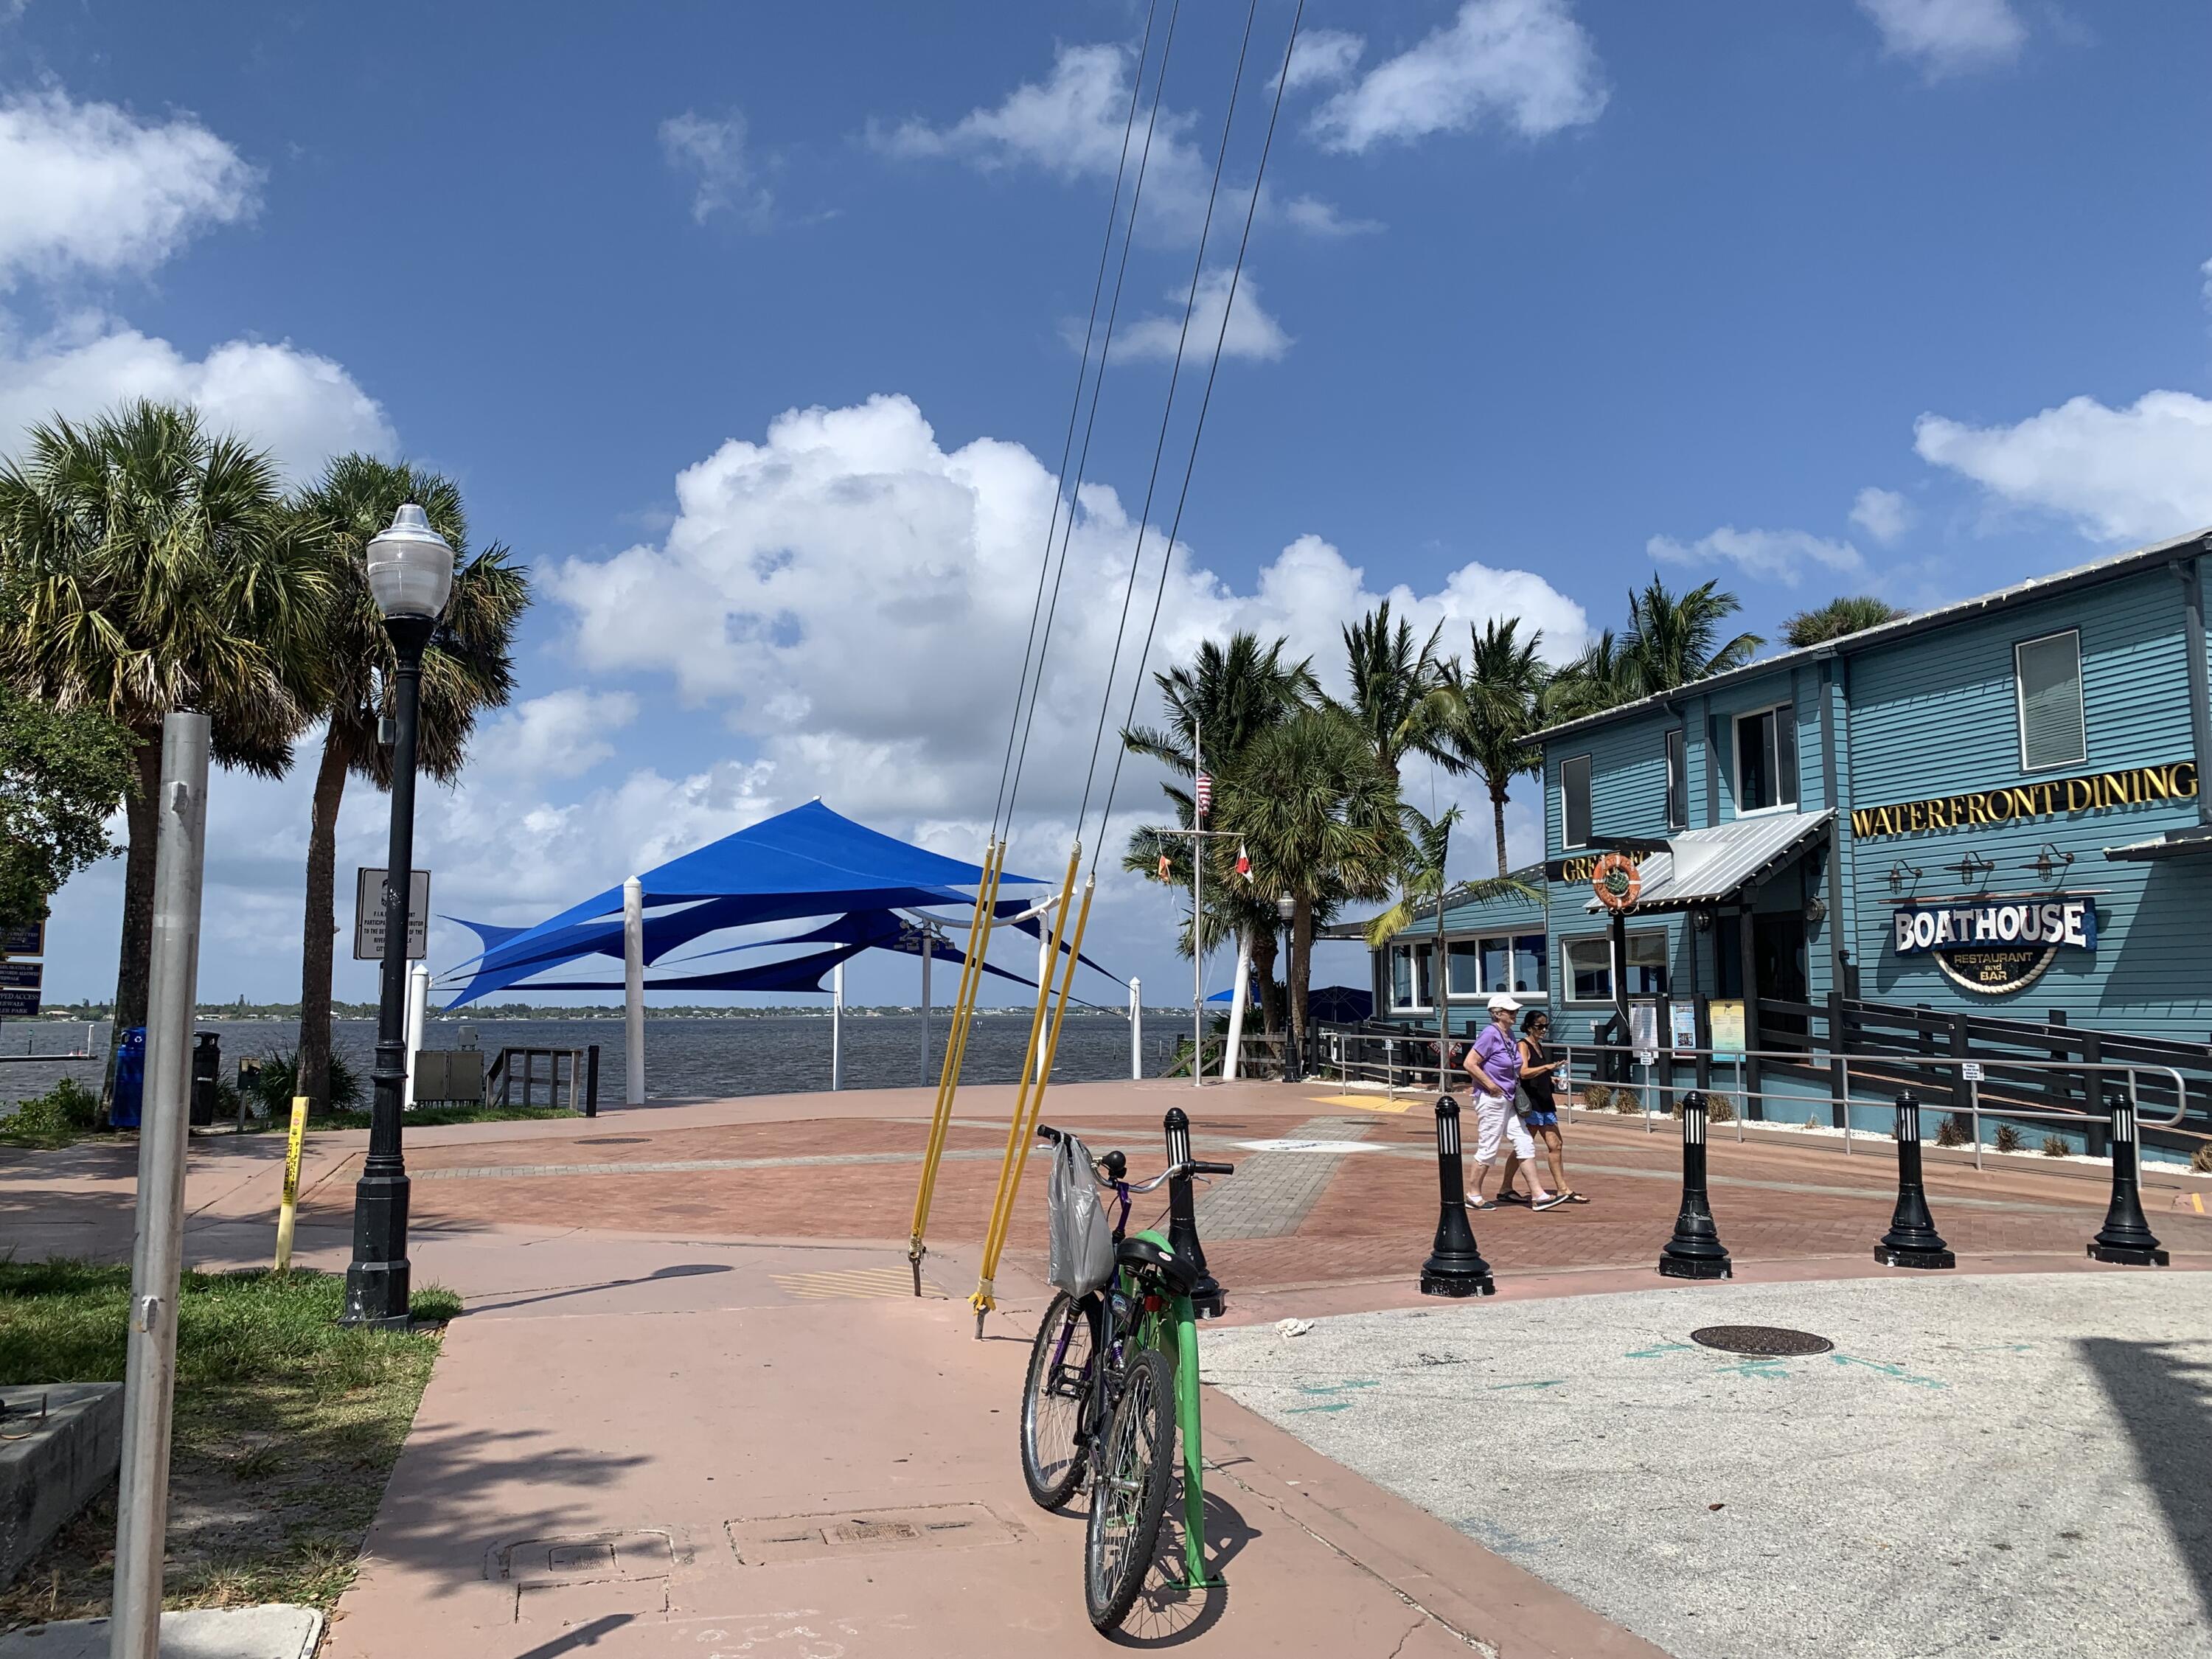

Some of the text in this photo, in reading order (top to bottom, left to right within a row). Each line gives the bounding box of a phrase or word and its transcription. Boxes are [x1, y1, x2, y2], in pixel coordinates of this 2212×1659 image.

[1852, 763, 2197, 838] WATERFRONT DINING
[1895, 900, 2086, 951] BOATHOUSE
[1954, 952, 2034, 964] RESTAURANT
[1985, 963, 2002, 971] and
[1980, 970, 2007, 981] BAR
[291, 1141, 299, 1193] PIPELINE
